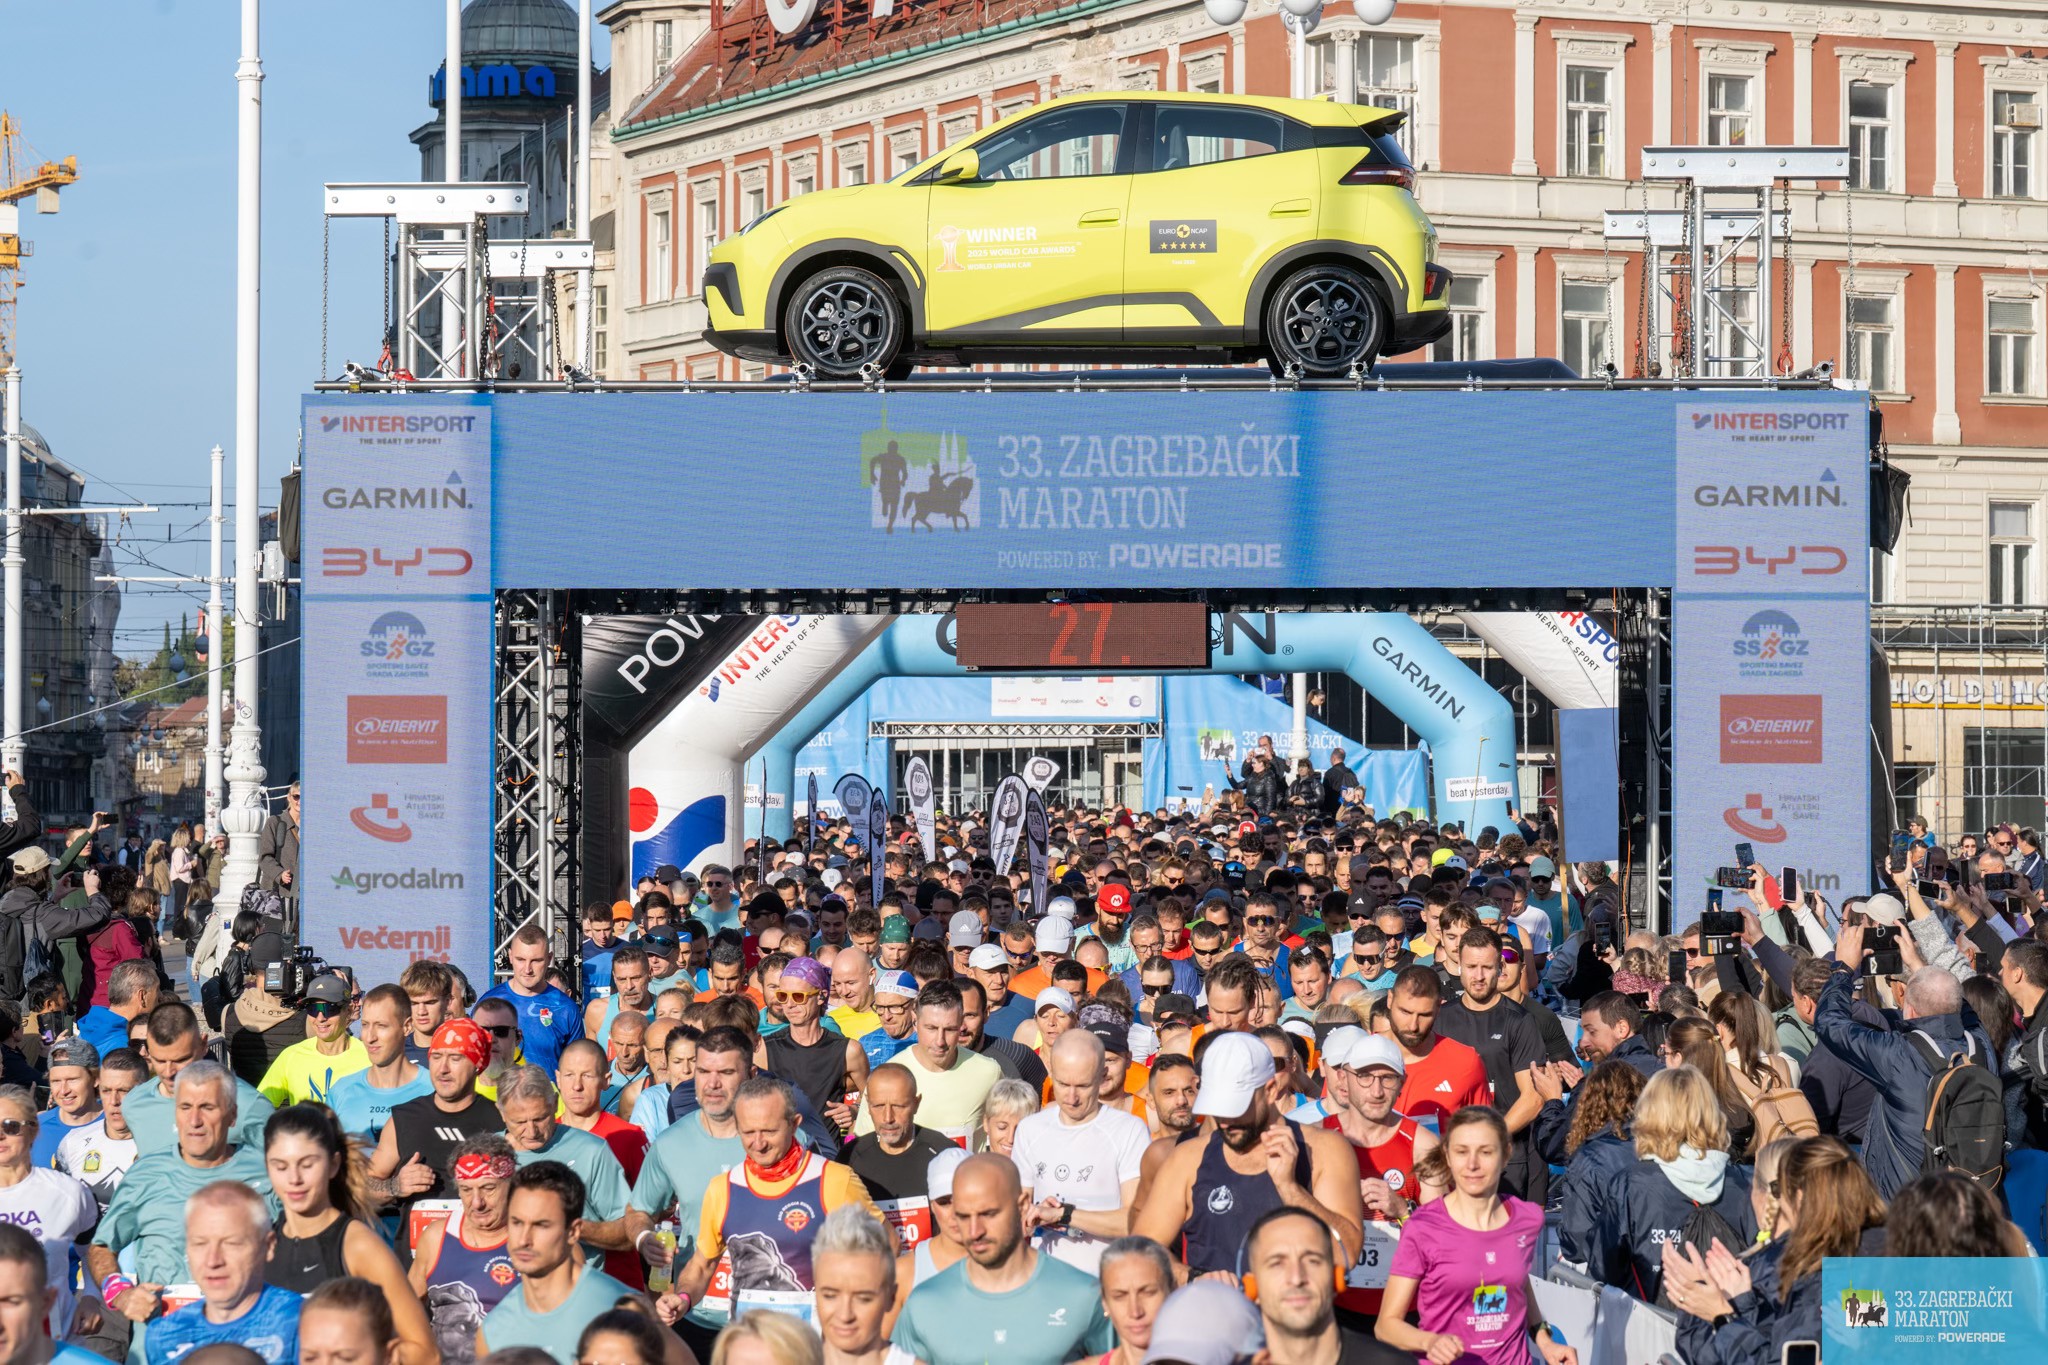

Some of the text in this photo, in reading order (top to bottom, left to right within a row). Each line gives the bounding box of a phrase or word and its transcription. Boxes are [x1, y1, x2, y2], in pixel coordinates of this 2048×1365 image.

[966, 226, 1037, 243] WINNER
[967, 245, 1076, 258] 2025 WORLD CAR AWARDS
[342, 415, 475, 432] INTERSPORT
[1714, 413, 1849, 430] INTERSPORT
[998, 422, 1301, 478] 33. ZAGREBAČKI
[998, 486, 1188, 530] MARATON
[322, 547, 473, 577] BYD
[998, 550, 1074, 570] POWERED
[1109, 543, 1283, 569] POWERADE
[1694, 546, 1848, 575] BYD
[754, 665, 772, 682] THE
[771, 640, 798, 666] HEART
[797, 628, 809, 642] OF
[1573, 646, 1601, 672] SPORT
[380, 719, 440, 733] ENERVIT
[1753, 719, 1815, 733] ENERVIT
[1450, 788, 1468, 797] beat
[332, 866, 464, 894] Agrodalm
[338, 925, 451, 953] Večernji
